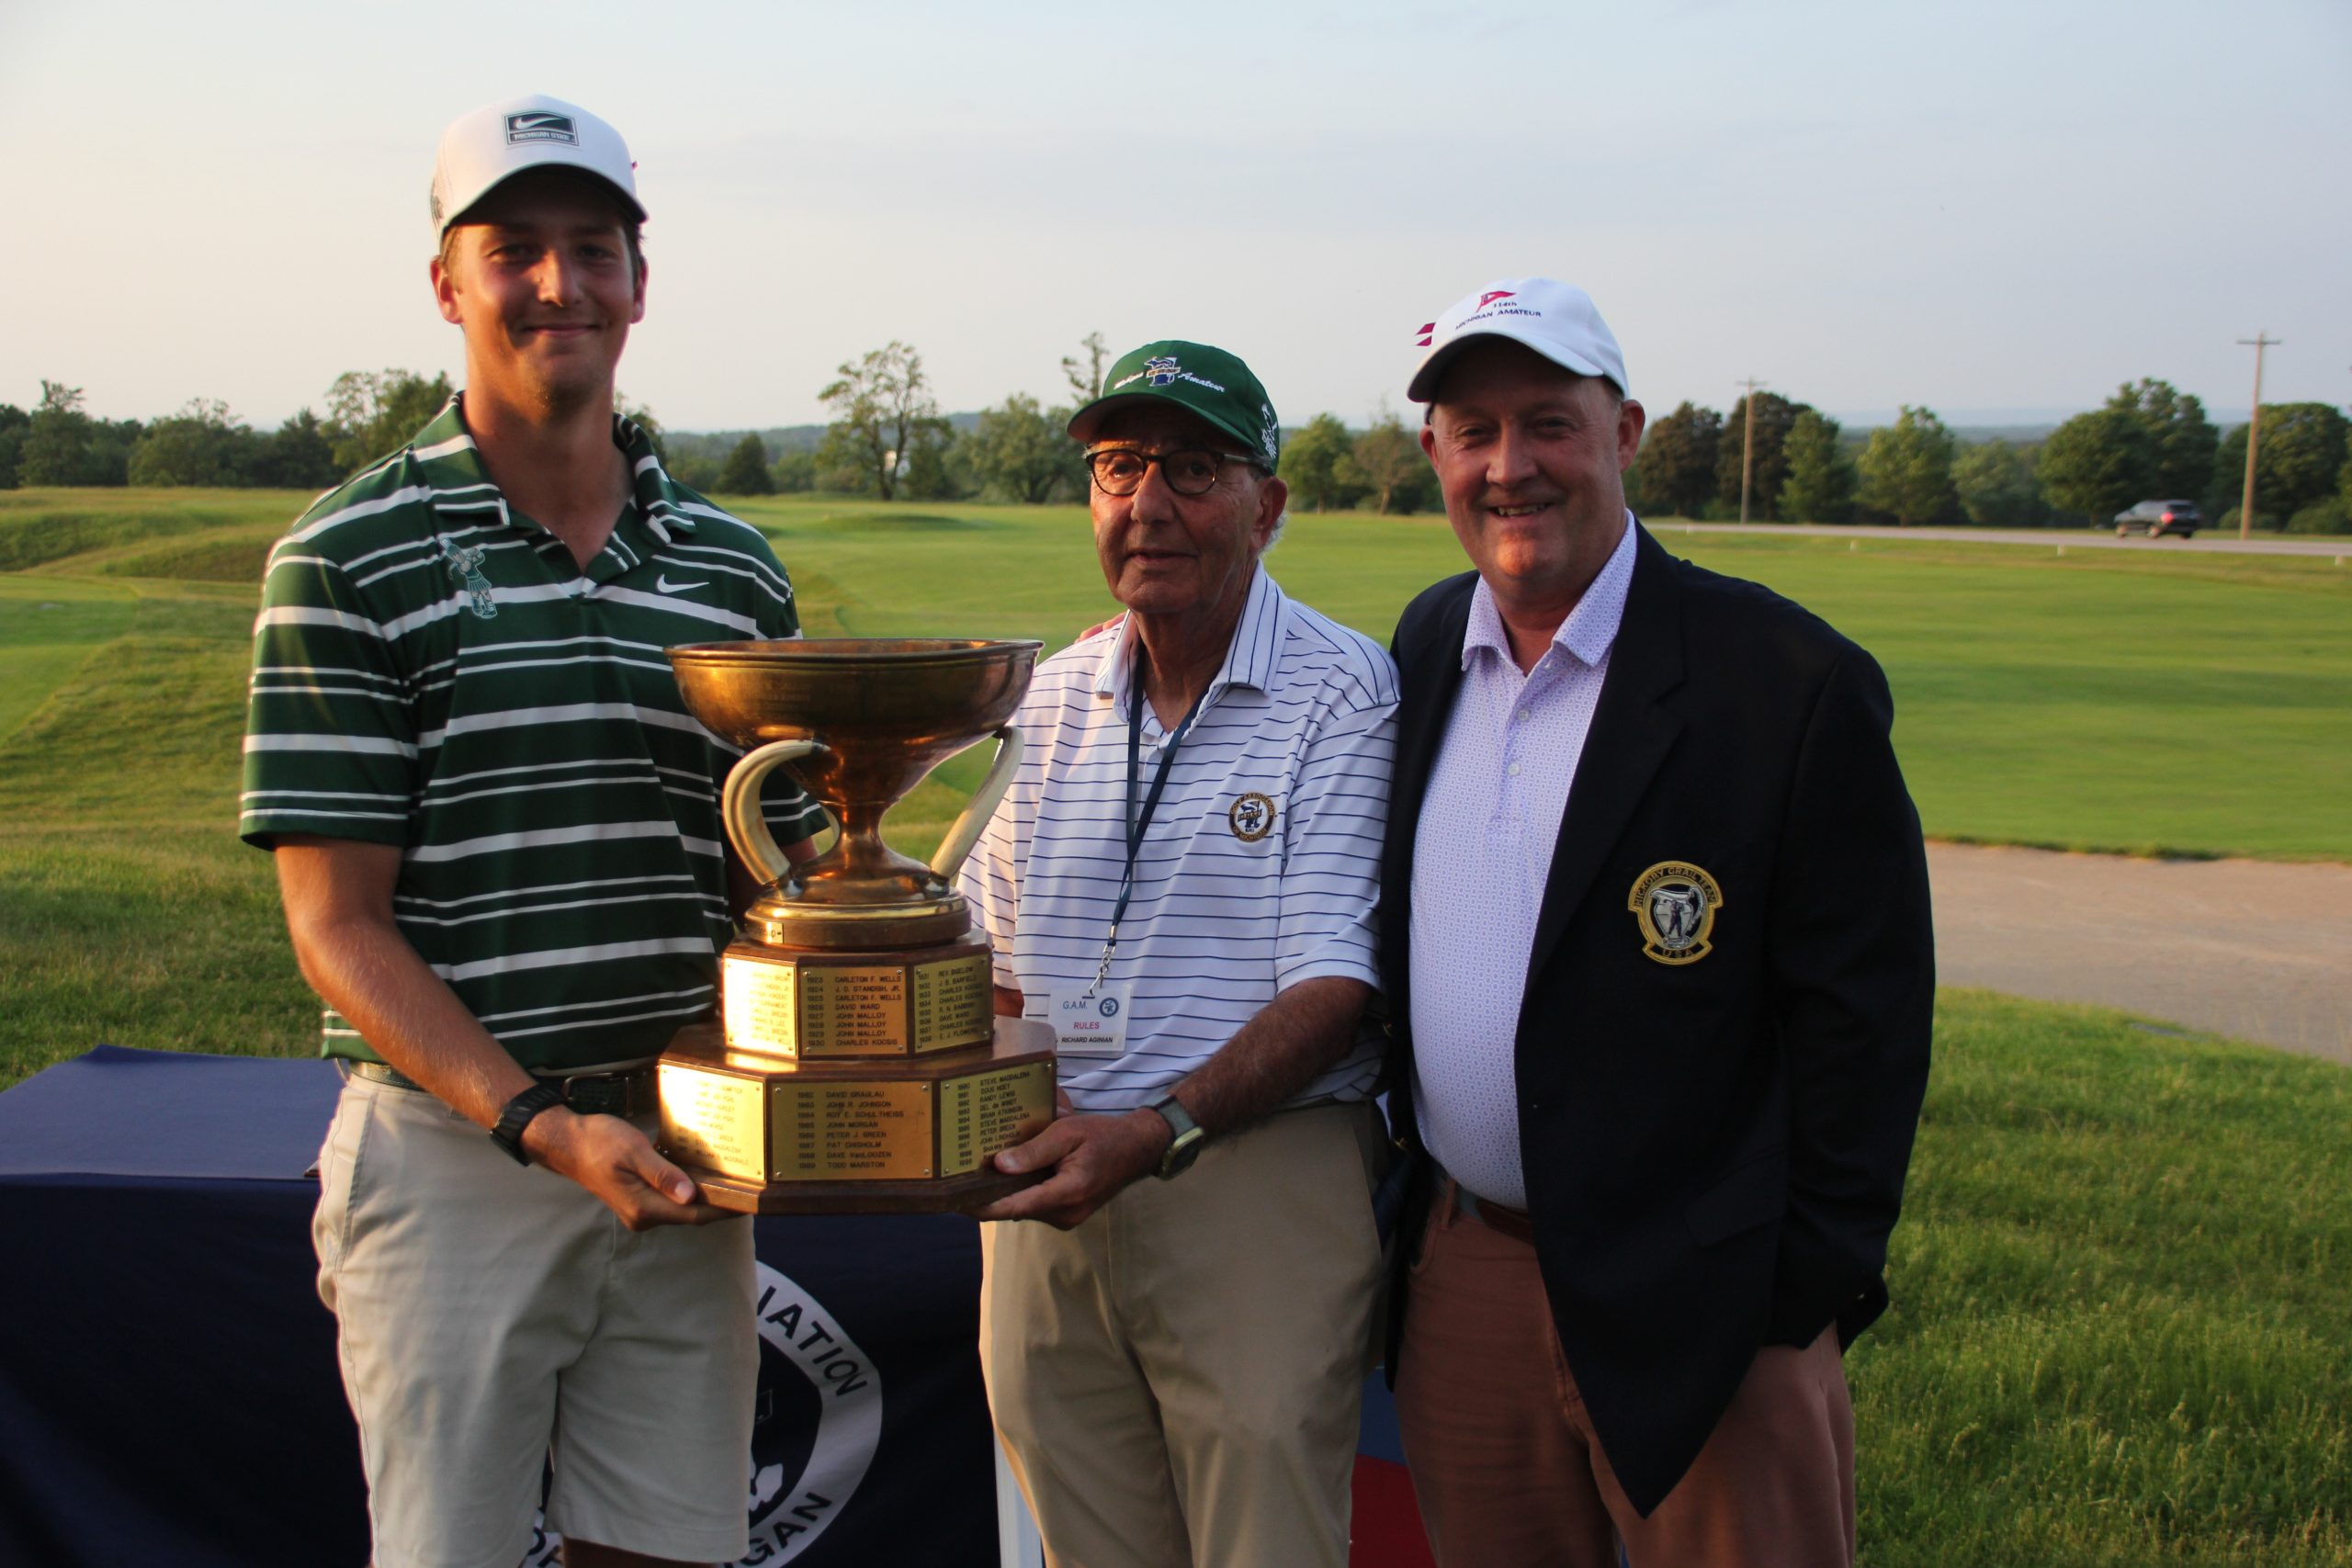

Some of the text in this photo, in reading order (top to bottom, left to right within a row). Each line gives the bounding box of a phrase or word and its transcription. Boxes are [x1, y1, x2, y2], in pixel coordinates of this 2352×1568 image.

[514, 131, 549, 141] MICHIGAN
[1454, 309, 1542, 331] MICHIGAN AMATEUR
[1634, 869, 1665, 907] HICKORY
[1073, 1021, 1100, 1030] RULES
[723, 1492, 832, 1568] GAN
